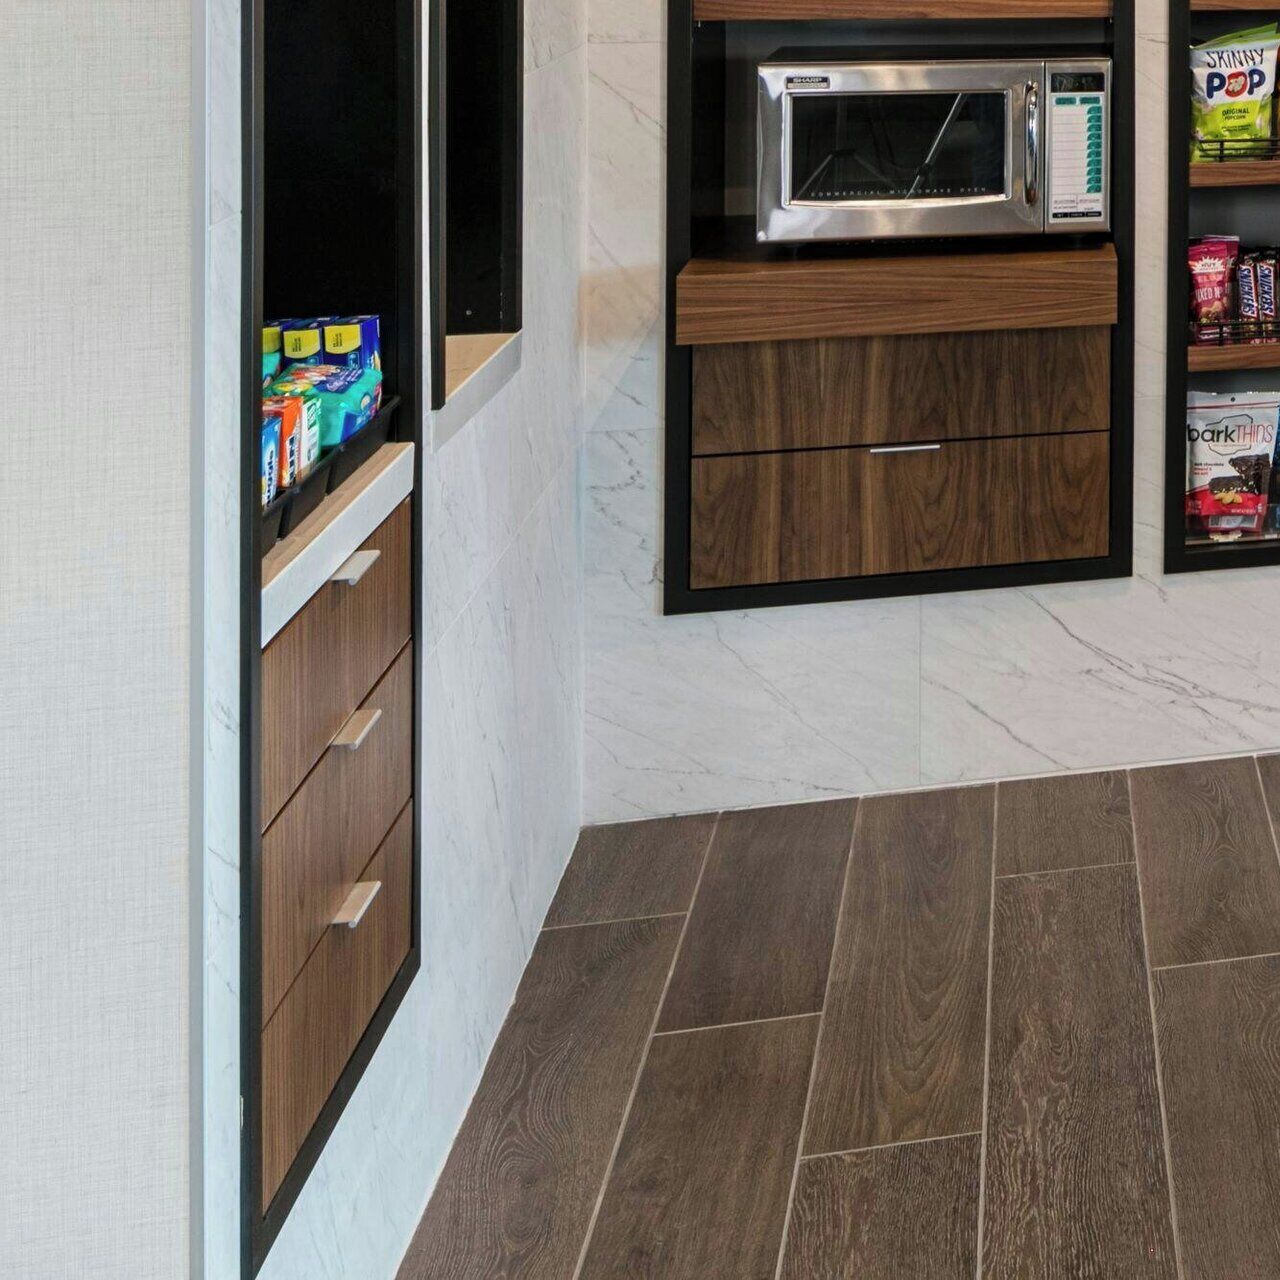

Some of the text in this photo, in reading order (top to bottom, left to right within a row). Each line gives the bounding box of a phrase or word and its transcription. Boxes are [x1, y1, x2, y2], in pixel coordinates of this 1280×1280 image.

[1205, 48, 1265, 68] SKINNY
[791, 76, 823, 84] SHARP
[1205, 67, 1266, 100] POP
[1221, 107, 1250, 116] ORIGINAL
[809, 186, 988, 198] COMMERCIAL MICROWAVE OVEN
[1239, 264, 1257, 316] SNICKERS
[1257, 263, 1275, 314] SNICKERS
